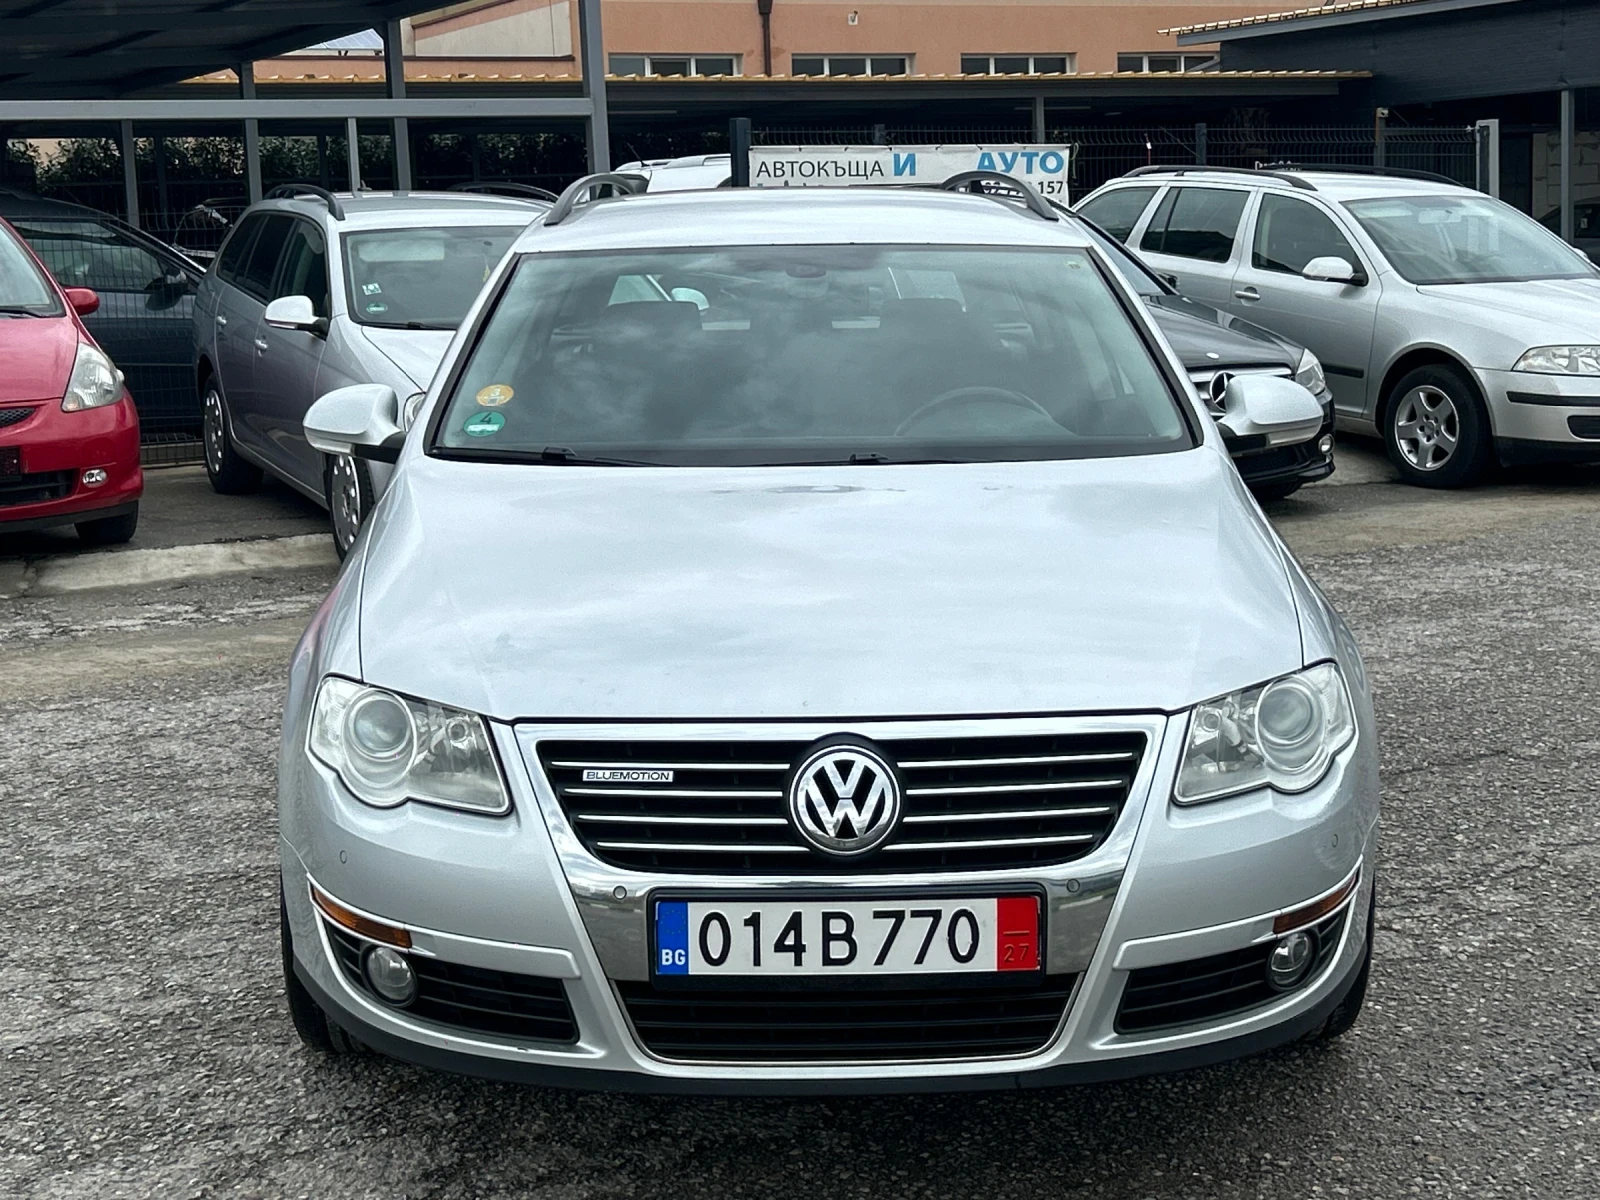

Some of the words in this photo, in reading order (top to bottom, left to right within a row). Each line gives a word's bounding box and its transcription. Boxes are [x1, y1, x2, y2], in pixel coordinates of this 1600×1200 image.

[756, 160, 884, 180] АВТОКЪЩА
[893, 153, 916, 176] И
[977, 151, 1064, 174] АУТО
[1038, 181, 1064, 194] 157
[480, 412, 492, 424] 4
[586, 771, 669, 781] BLUEMOTION
[661, 949, 686, 966] BG
[699, 909, 980, 967] 014B770
[1004, 943, 1029, 962] 27
